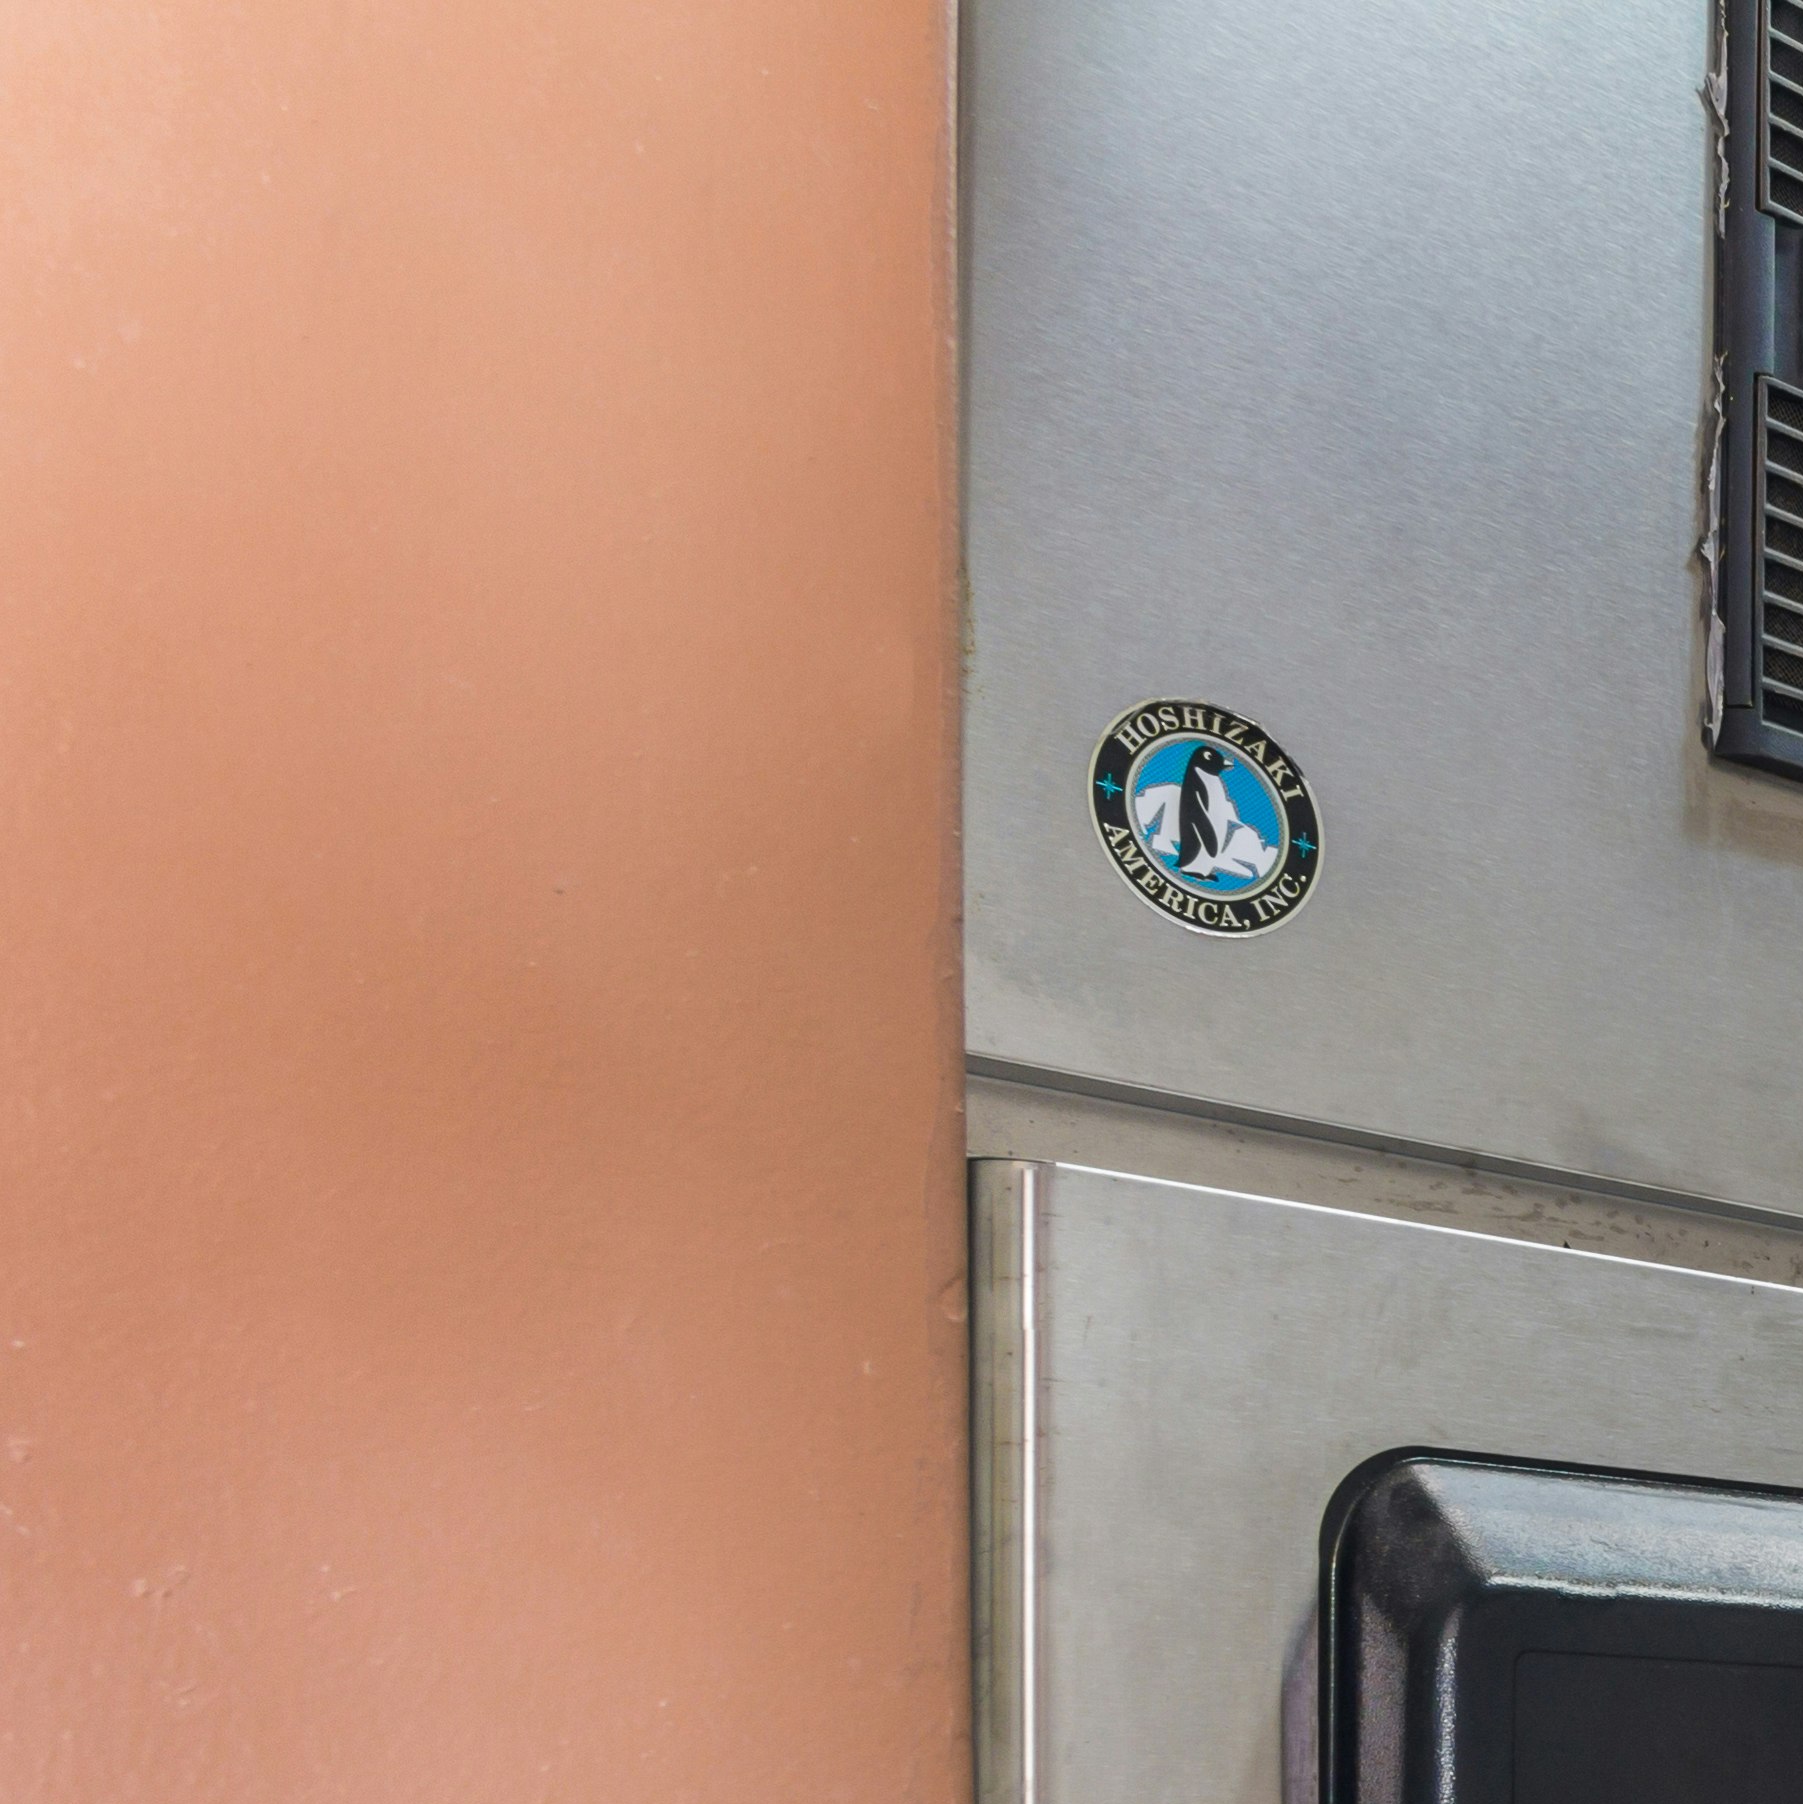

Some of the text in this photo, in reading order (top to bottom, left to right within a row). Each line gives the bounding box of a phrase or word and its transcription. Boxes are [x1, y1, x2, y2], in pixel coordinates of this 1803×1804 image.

[1114, 705, 1304, 802] HOSHIZAKI
[1104, 822, 1307, 930] AMERICA, INC.
